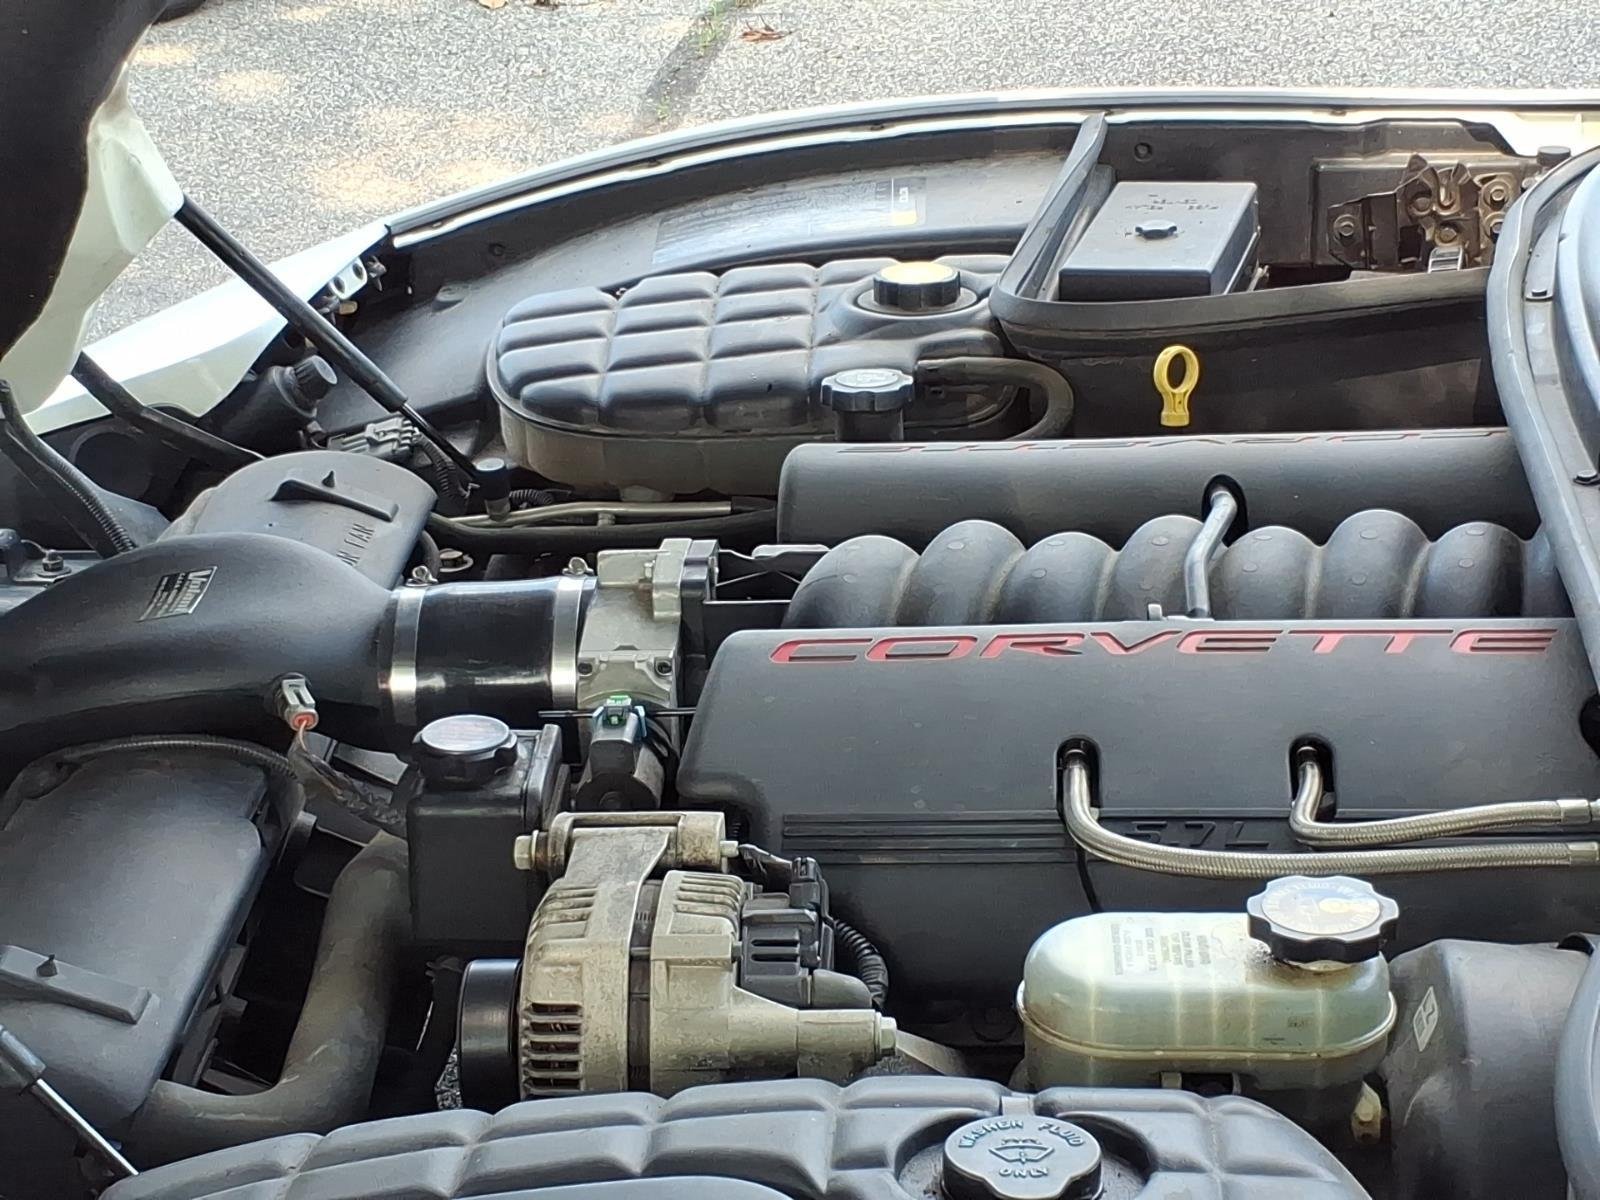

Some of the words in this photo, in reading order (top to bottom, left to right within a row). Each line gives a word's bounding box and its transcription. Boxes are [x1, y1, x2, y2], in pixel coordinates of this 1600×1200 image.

[770, 628, 1557, 663] CORVETTE
[958, 1119, 1024, 1149] WASHER
[1037, 1121, 1086, 1147] FLUID
[999, 1167, 1049, 1178] ONLY
